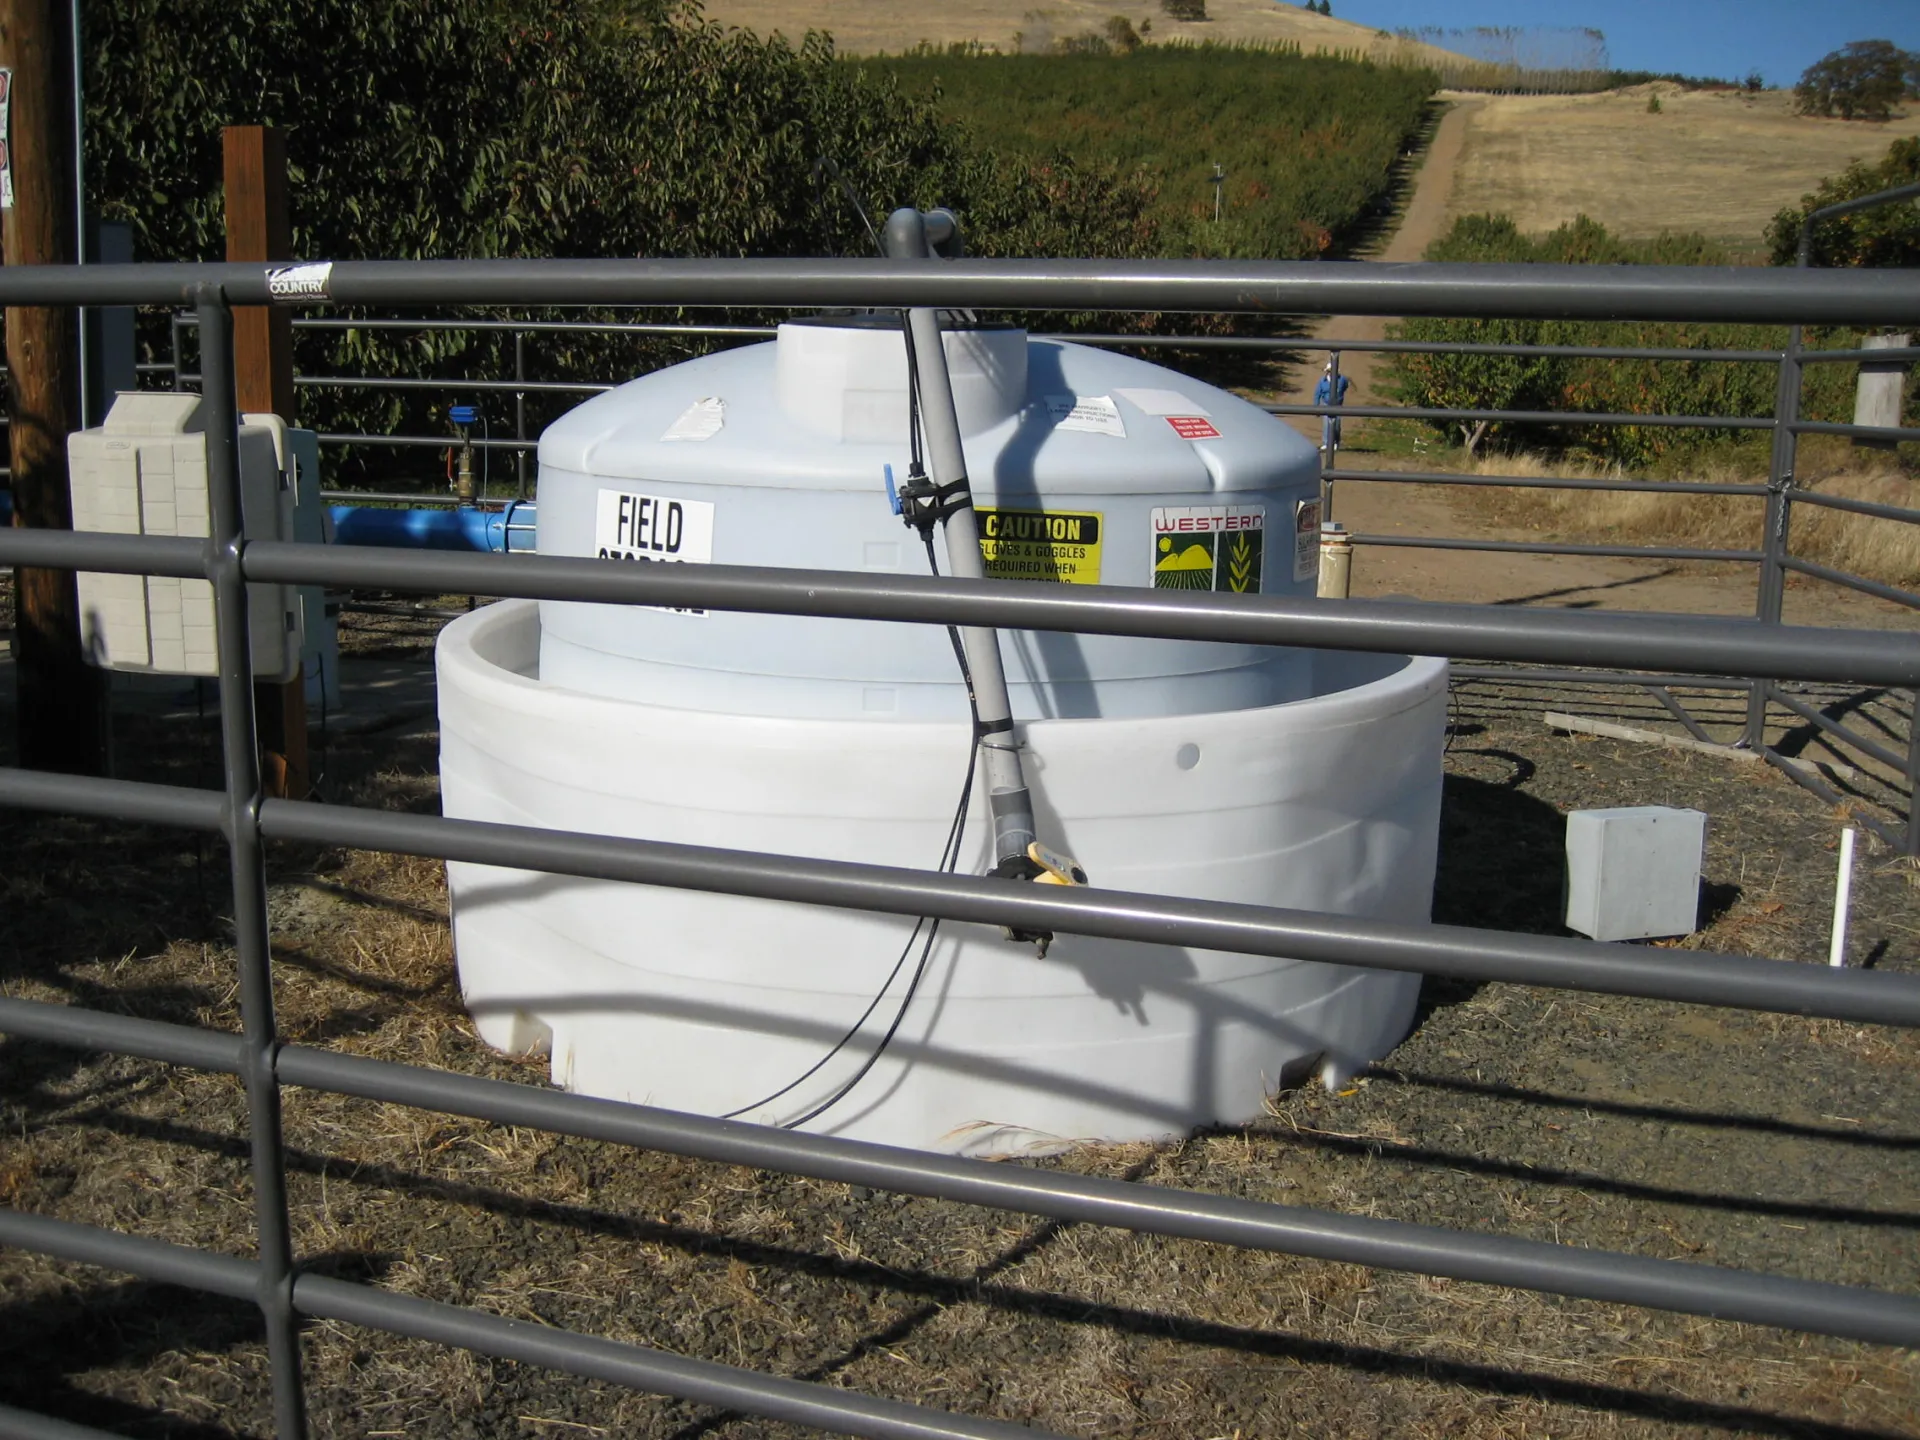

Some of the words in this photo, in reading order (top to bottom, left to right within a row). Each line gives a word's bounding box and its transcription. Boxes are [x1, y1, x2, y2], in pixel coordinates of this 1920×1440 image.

[270, 281, 323, 294] COUNTRY
[617, 494, 683, 553] FIELD
[985, 514, 1081, 540] CAUTION
[1155, 515, 1263, 532] WESTERN
[980, 542, 1020, 556] GLOVES
[1024, 545, 1032, 557] &
[1035, 546, 1086, 559] GOGGLES
[984, 559, 1041, 573] REQUIRED
[1044, 563, 1076, 574] WHEN
